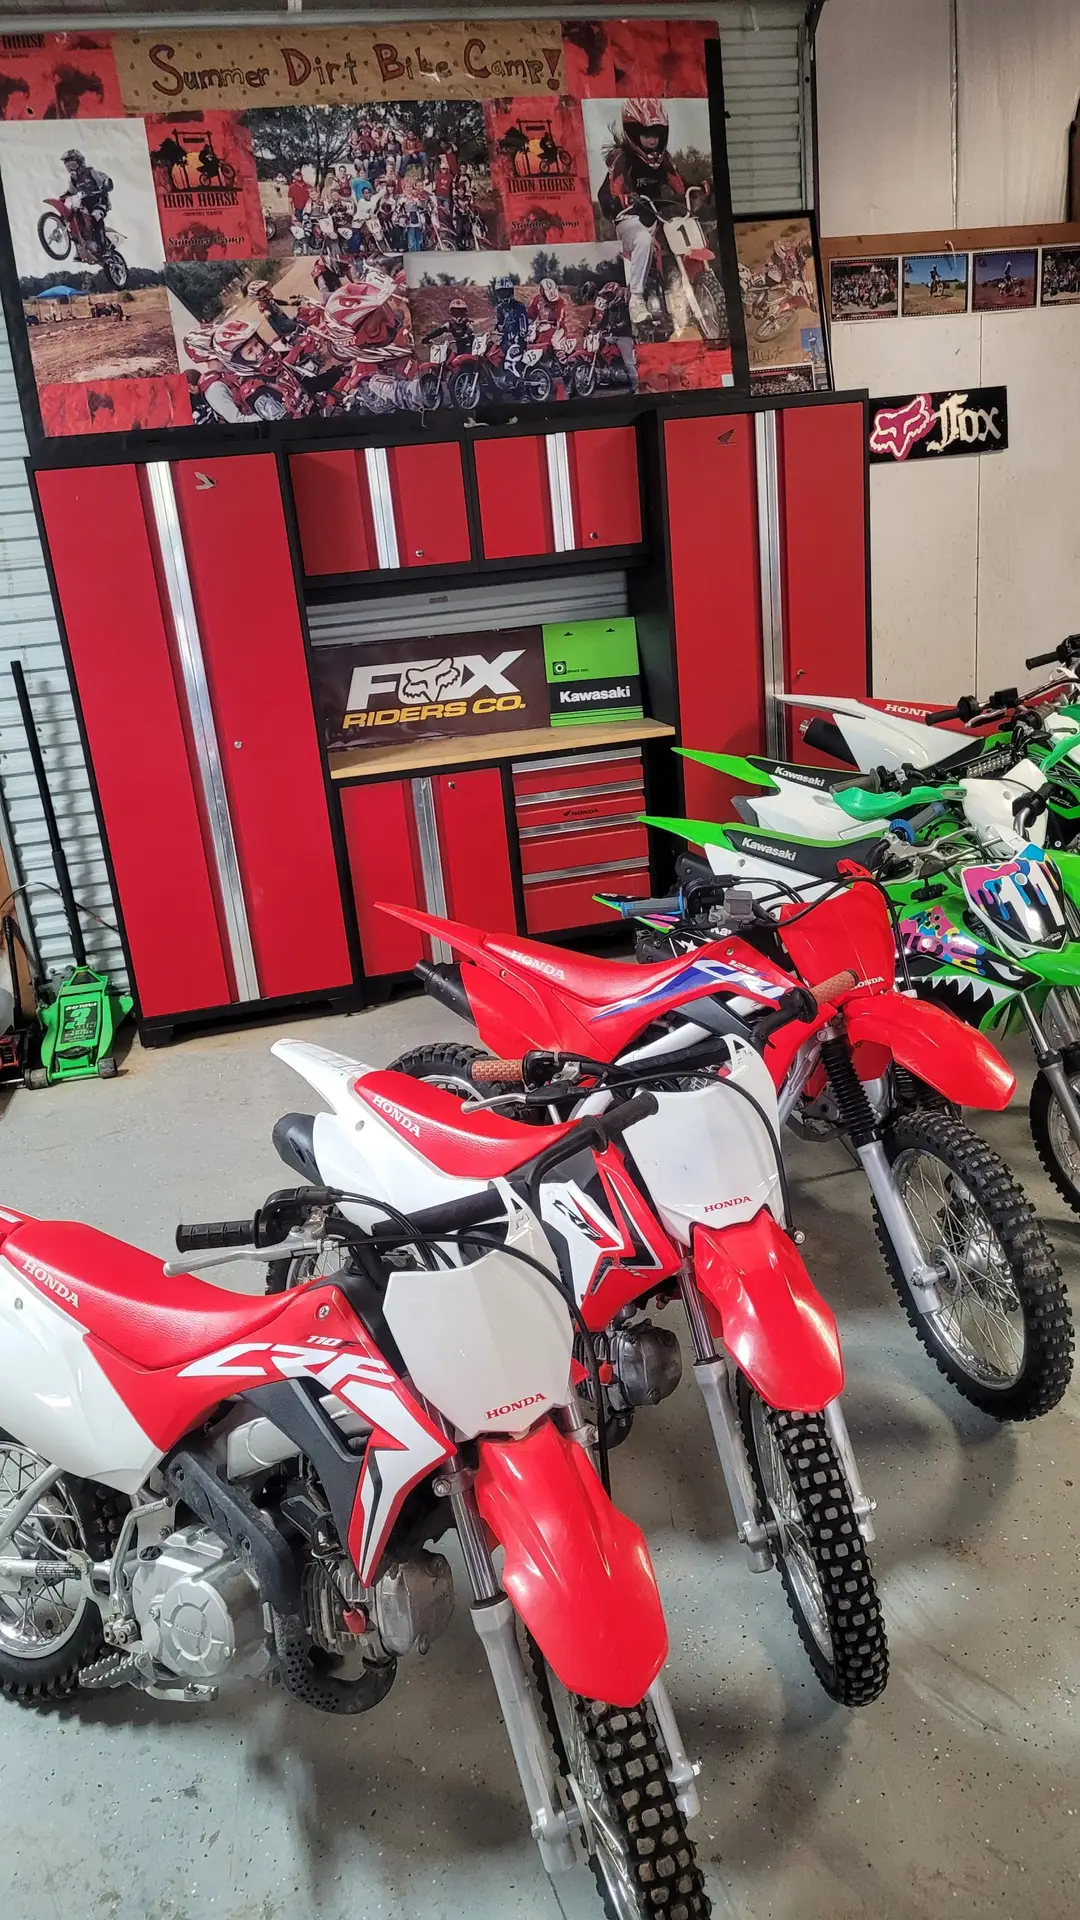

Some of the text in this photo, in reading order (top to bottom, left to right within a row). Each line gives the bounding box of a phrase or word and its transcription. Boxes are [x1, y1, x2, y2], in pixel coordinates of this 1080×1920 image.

[149, 38, 562, 96] Summer Dirt Bike Camp!
[508, 177, 576, 193] IRON HORSE
[163, 191, 239, 208] IRON HORSE
[676, 224, 692, 247] 1
[527, 350, 537, 363] 15
[926, 393, 1002, 452] Fox
[346, 649, 527, 711] FOX
[560, 685, 631, 704] Kawasaki
[342, 695, 527, 730] RIDERS CO.
[884, 703, 933, 717] HOND
[774, 766, 826, 787] Kawasaki
[741, 837, 798, 862] Kawasaki
[510, 950, 565, 981] HONDA
[851, 976, 886, 990] ONDA
[371, 1093, 421, 1138] HONDA
[703, 1196, 753, 1213] HONDA
[22, 1259, 79, 1309] HONDA
[306, 1335, 360, 1350] 110F
[176, 1342, 396, 1392] CRF
[484, 1392, 547, 1420] HONDA
